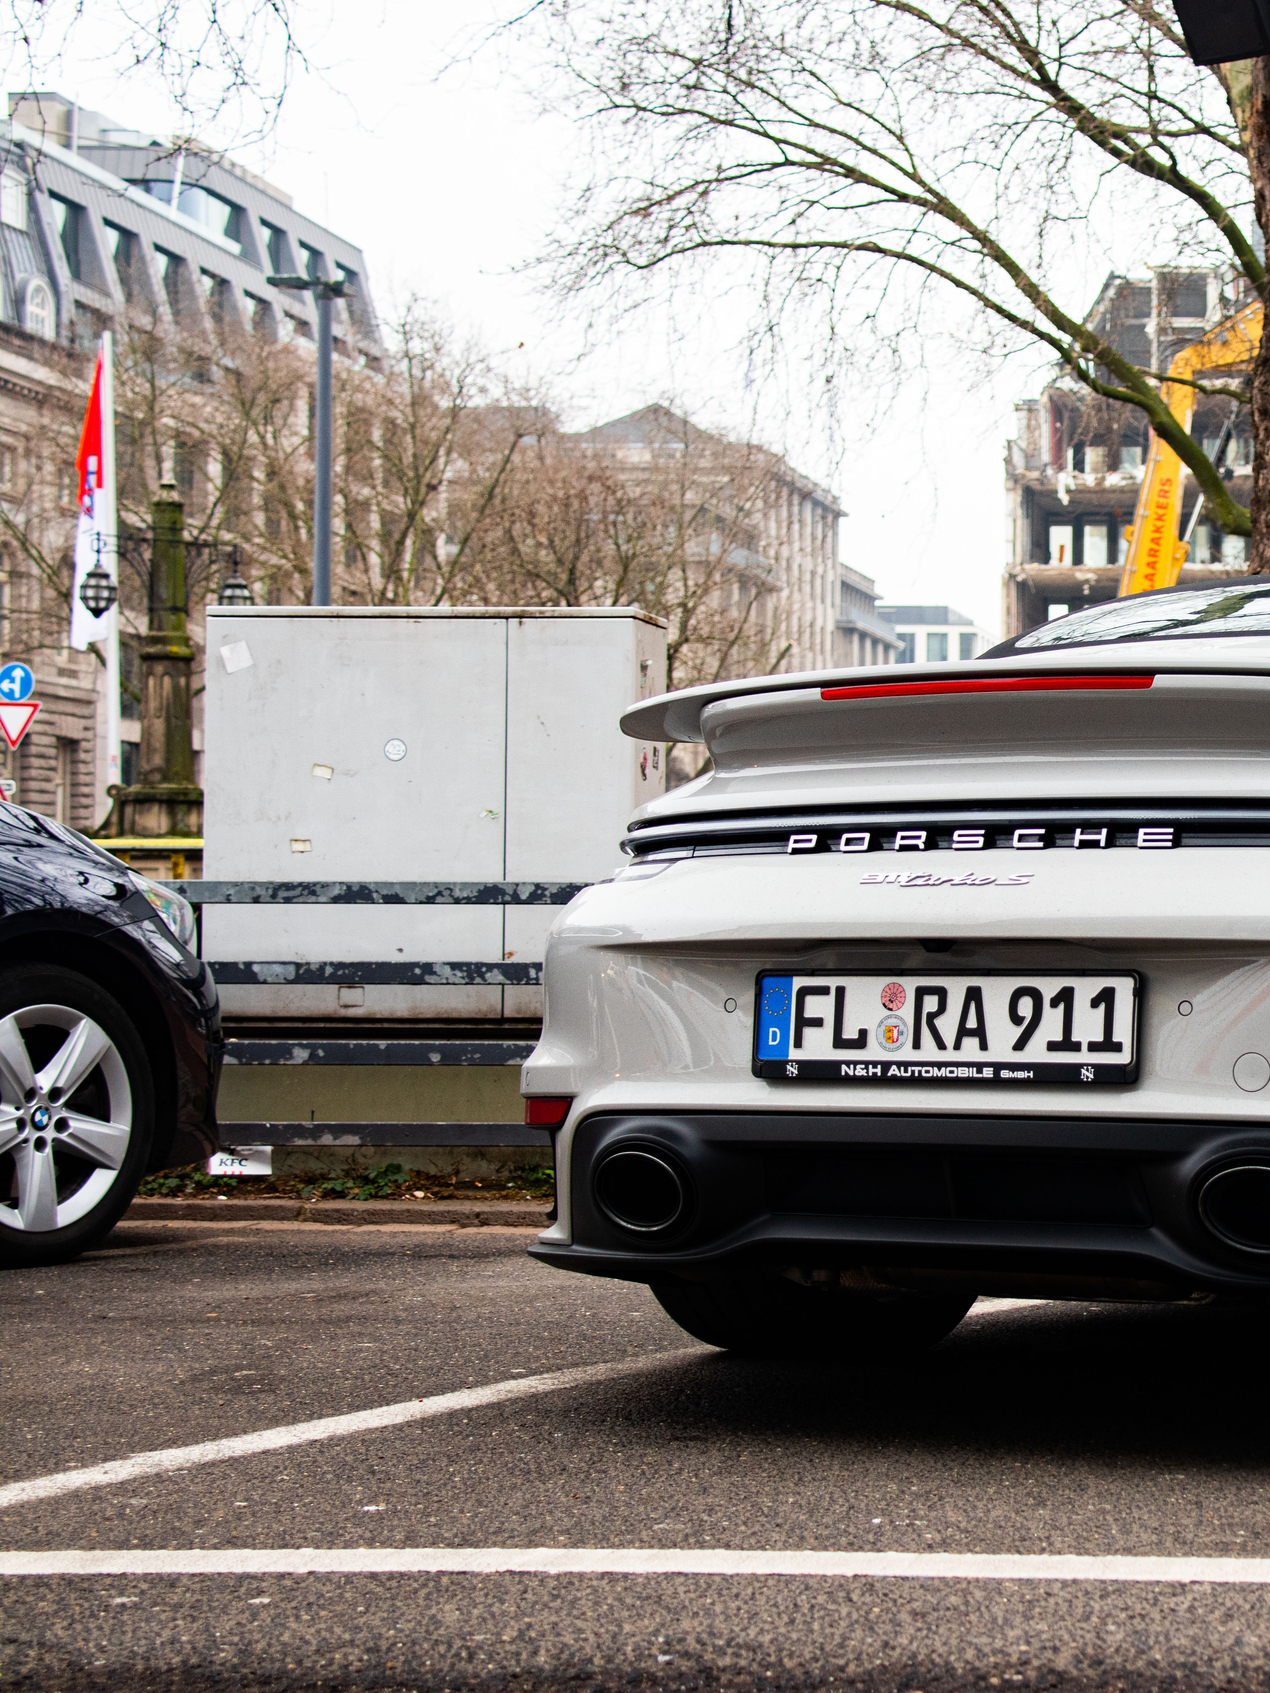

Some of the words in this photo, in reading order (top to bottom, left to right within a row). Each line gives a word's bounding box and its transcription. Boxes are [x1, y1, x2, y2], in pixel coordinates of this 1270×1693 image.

[787, 827, 1174, 854] PORSCHE
[995, 873, 1035, 886] S
[793, 985, 868, 1050] FL
[912, 985, 989, 1051] RA
[1008, 985, 1123, 1052] 911
[768, 1027, 780, 1045] D
[841, 1064, 881, 1076] N&H
[219, 1158, 248, 1167] KFC
